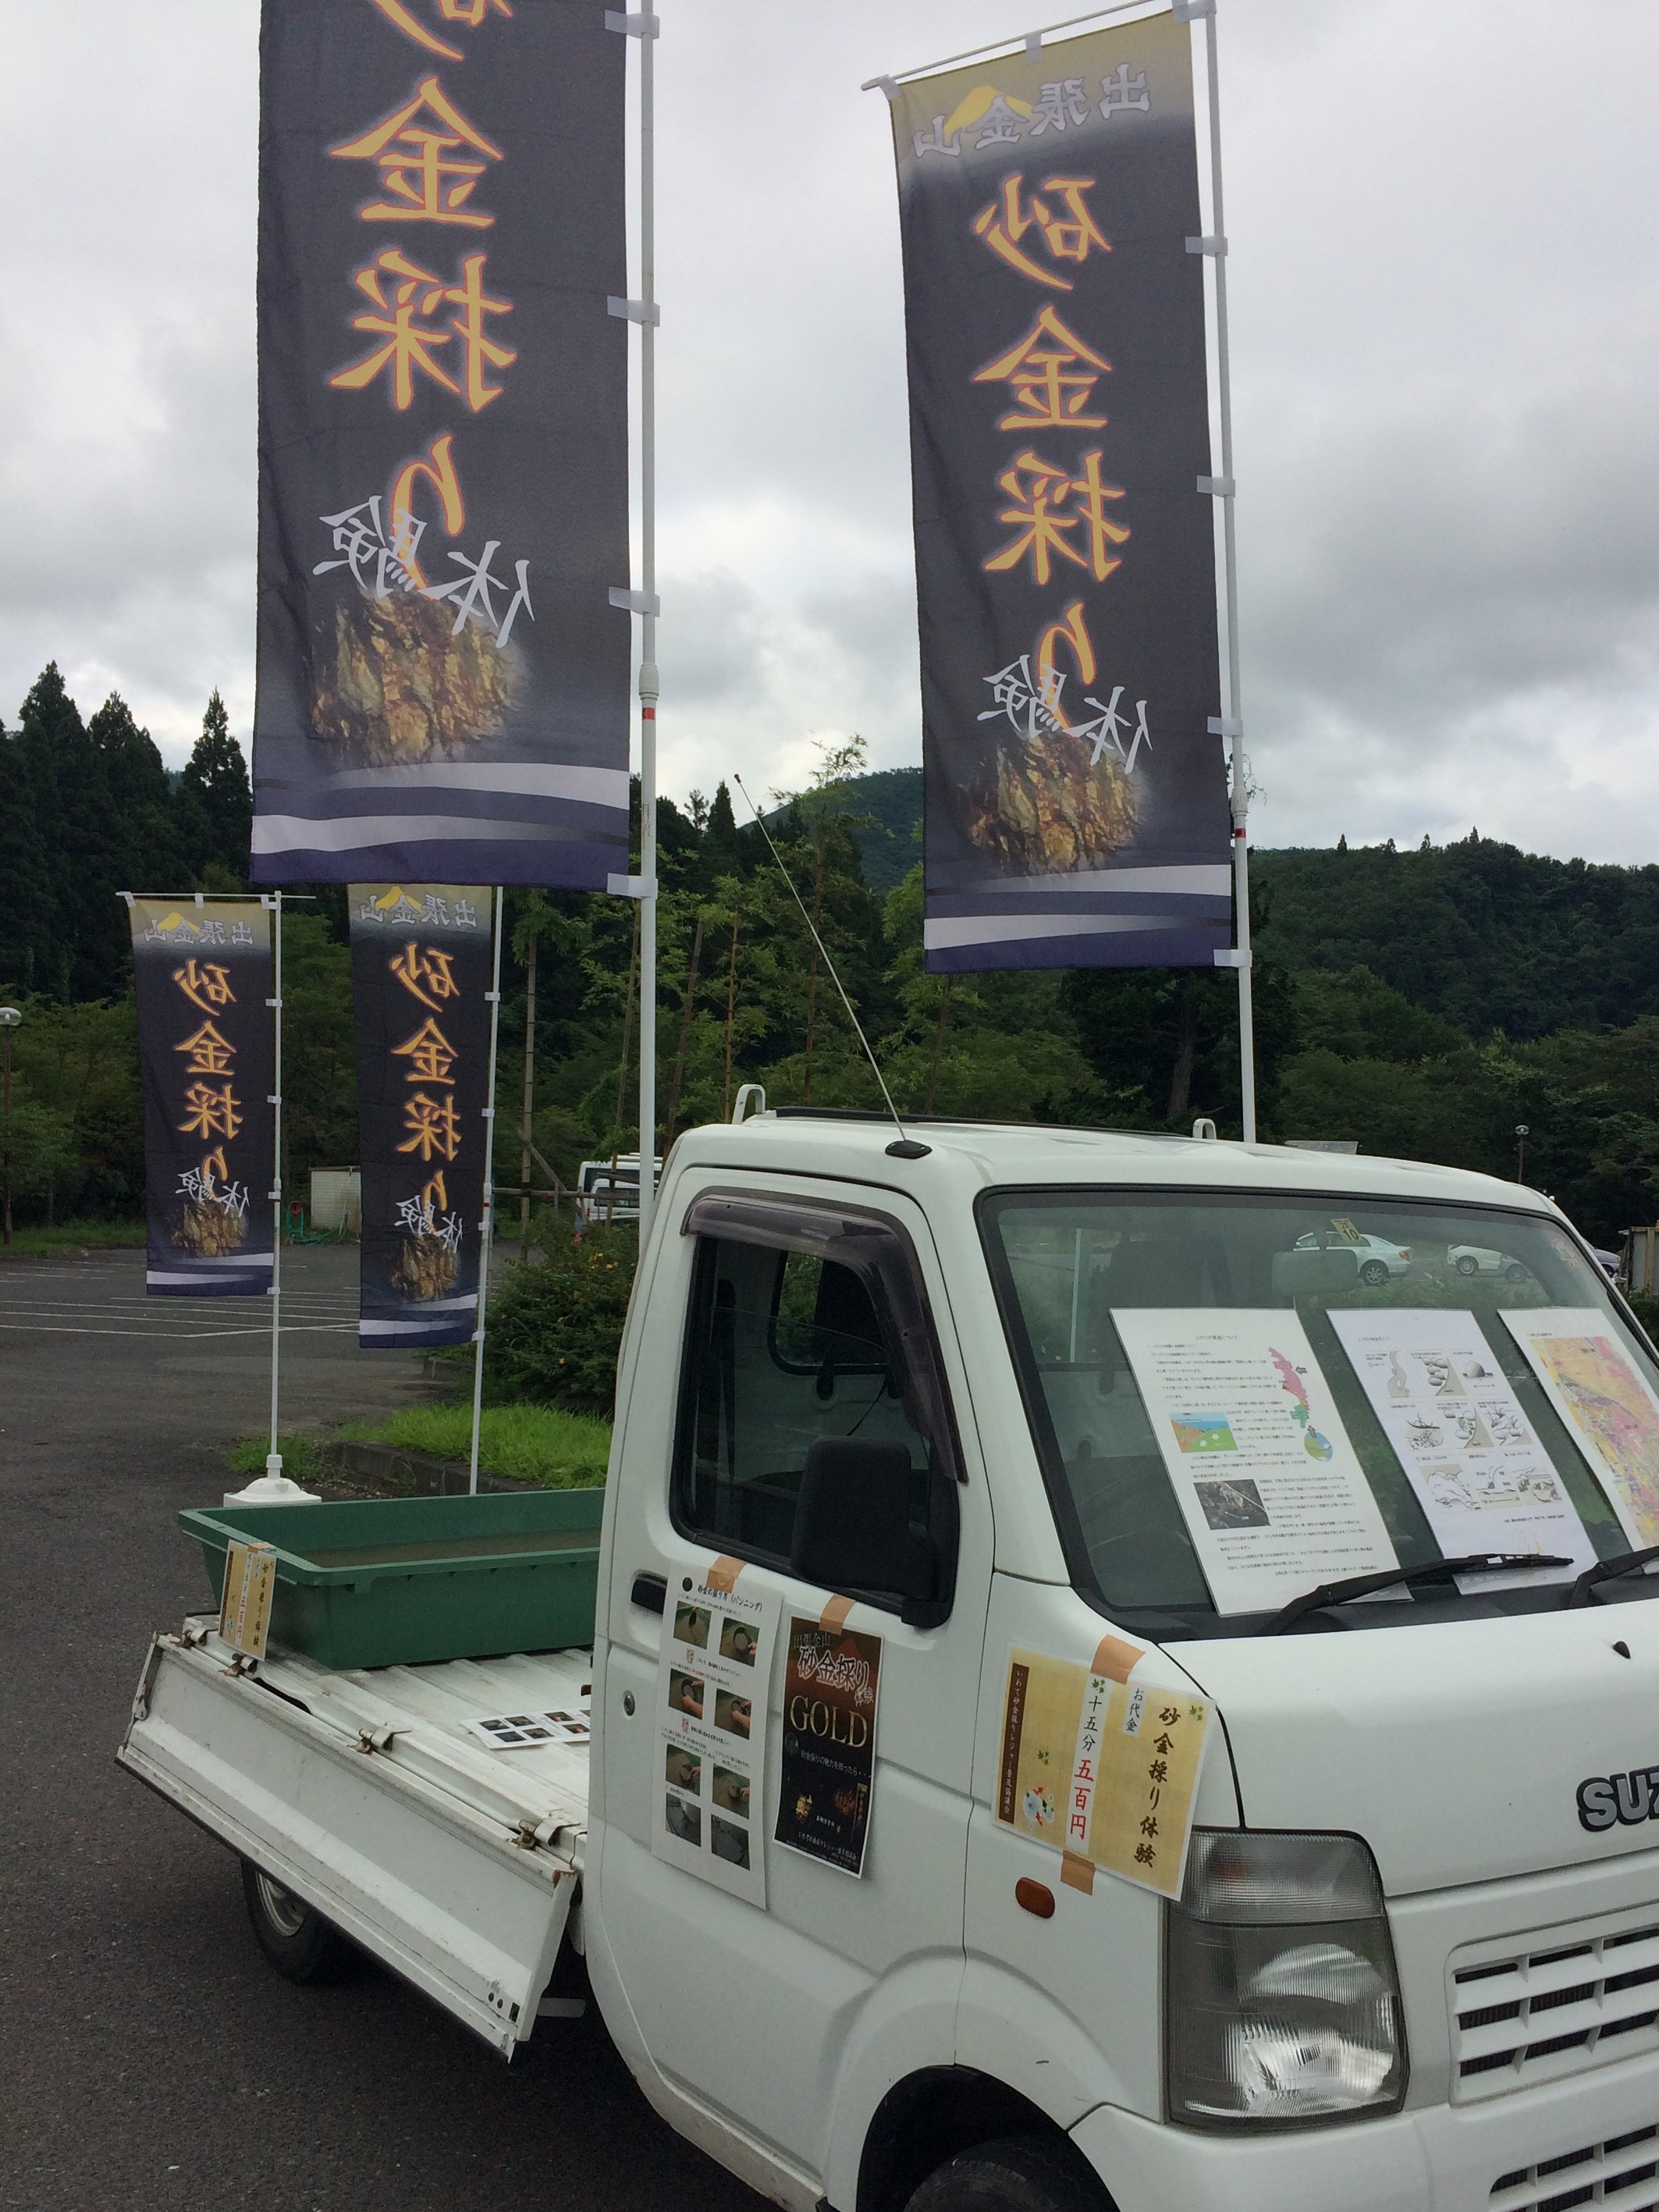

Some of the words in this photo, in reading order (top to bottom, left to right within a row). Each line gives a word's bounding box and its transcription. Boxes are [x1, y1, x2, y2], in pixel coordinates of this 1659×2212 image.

[798, 1645, 870, 1692] 砂金採り
[790, 1695, 868, 1748] GOLD
[1126, 1687, 1145, 1733] お代金
[1134, 1706, 1181, 1869] 砂金採り体験
